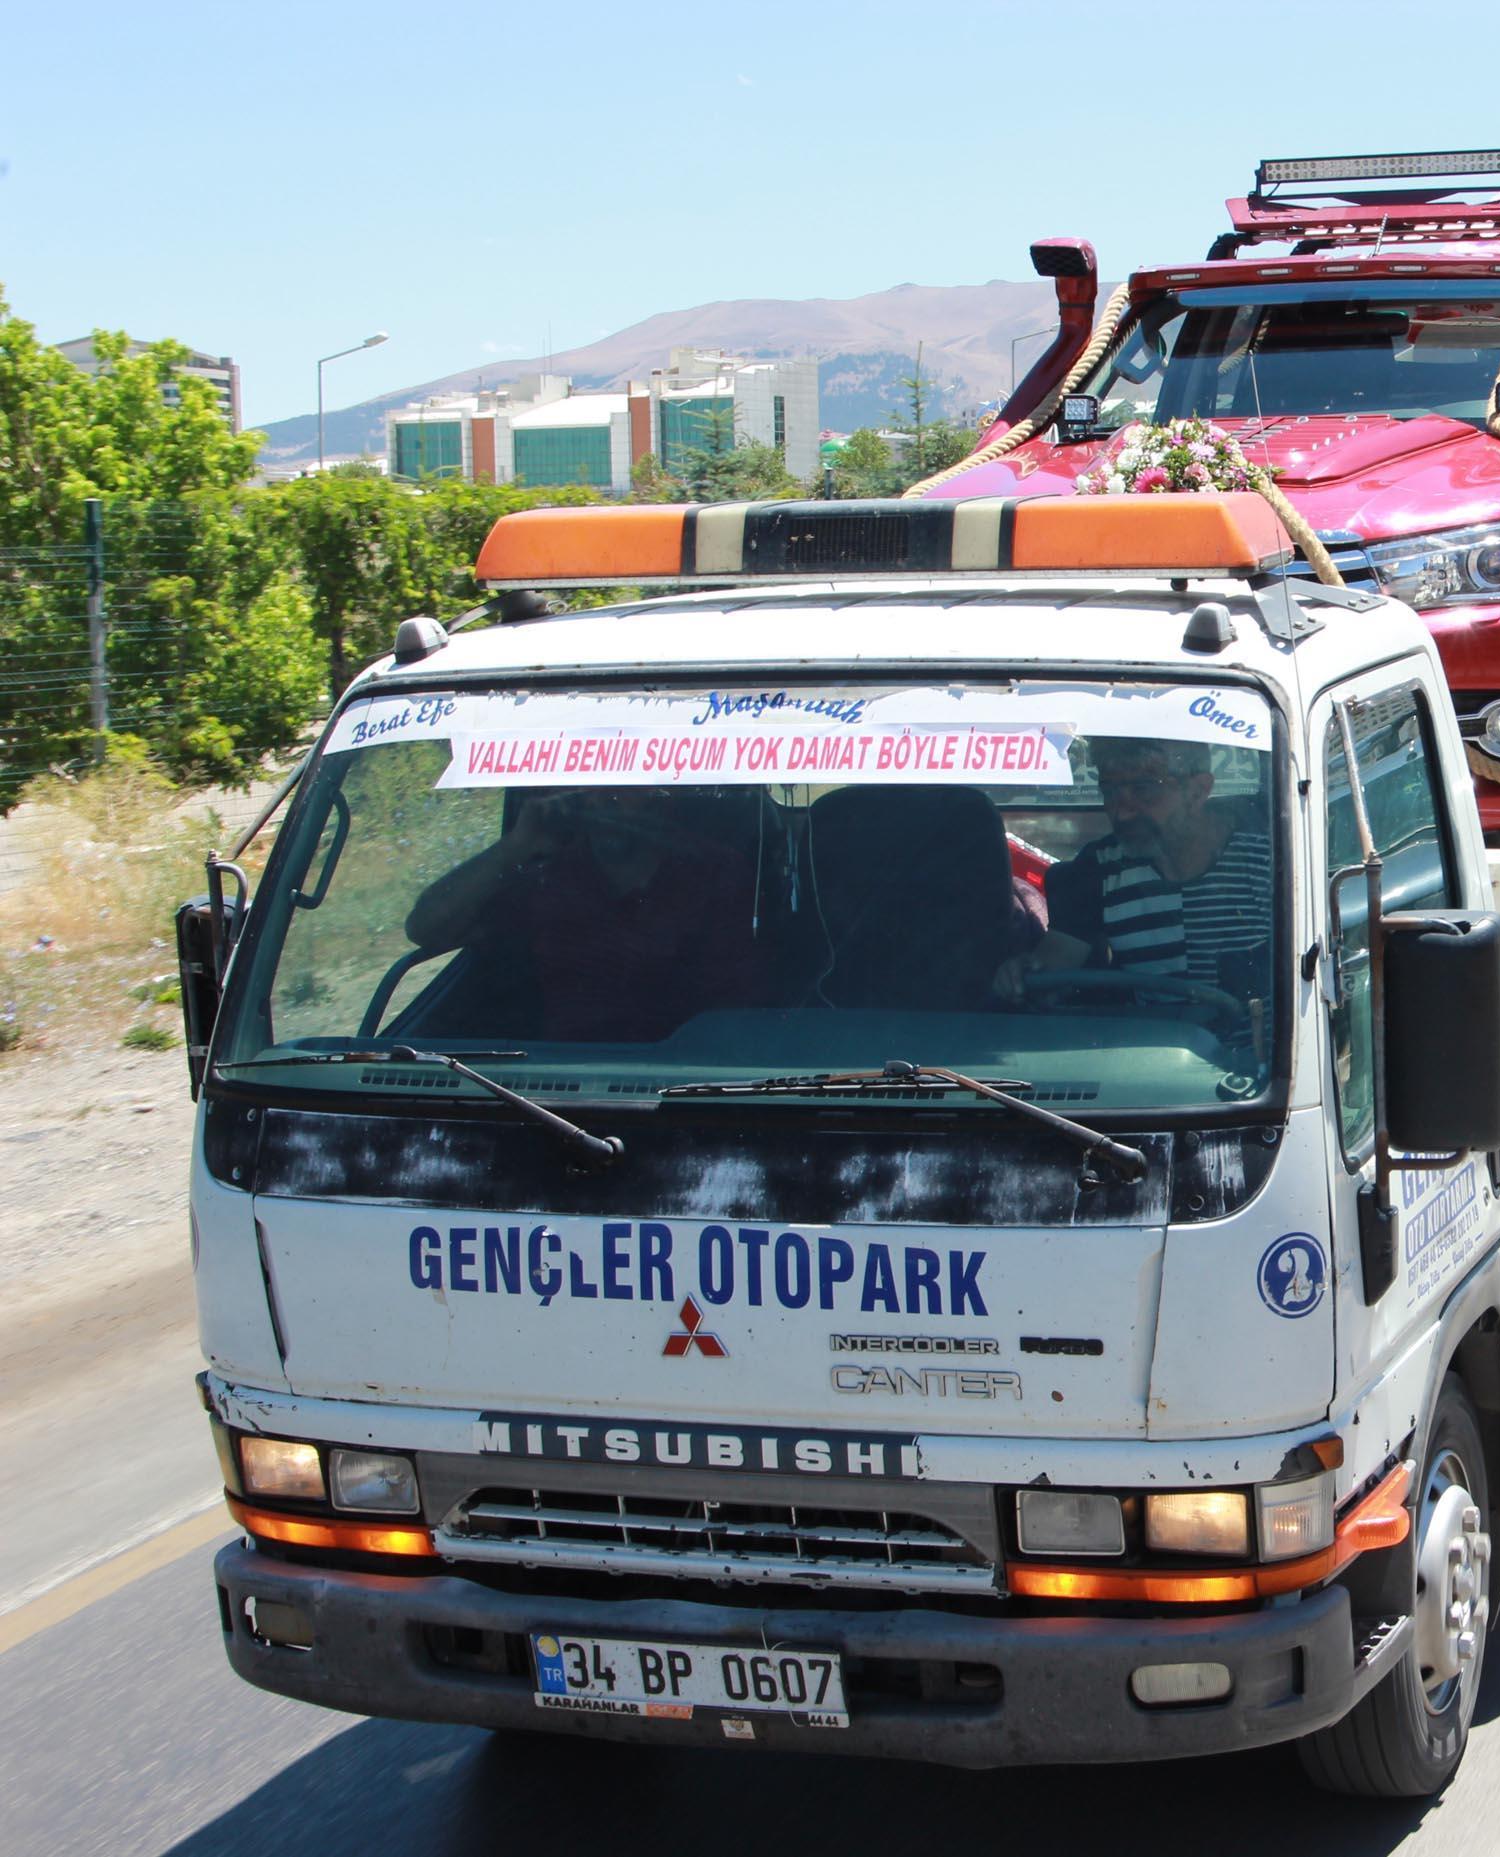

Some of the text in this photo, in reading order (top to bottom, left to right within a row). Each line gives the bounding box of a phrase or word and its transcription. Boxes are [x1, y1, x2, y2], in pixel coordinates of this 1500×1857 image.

[352, 698, 458, 745] Berat Efe
[1188, 690, 1259, 740] Ömer
[467, 730, 562, 775] VALLAHİ
[564, 729, 639, 772] BENİM
[643, 736, 728, 780] SUÇUM
[735, 735, 784, 770] YOK
[787, 734, 872, 771] DAMAT
[876, 728, 955, 770] BÖYLE
[962, 725, 1049, 770] İSTEDİ.
[410, 1223, 989, 1316] GENÇLER OTOPARK
[830, 1334, 999, 1355] INTERCOOLER
[831, 1364, 1022, 1400] CANTER
[473, 1420, 919, 1477] MITSUBISHI
[544, 1643, 832, 1705] TR 34 BP 0607
[543, 1696, 640, 1713] KARAHANLAR
